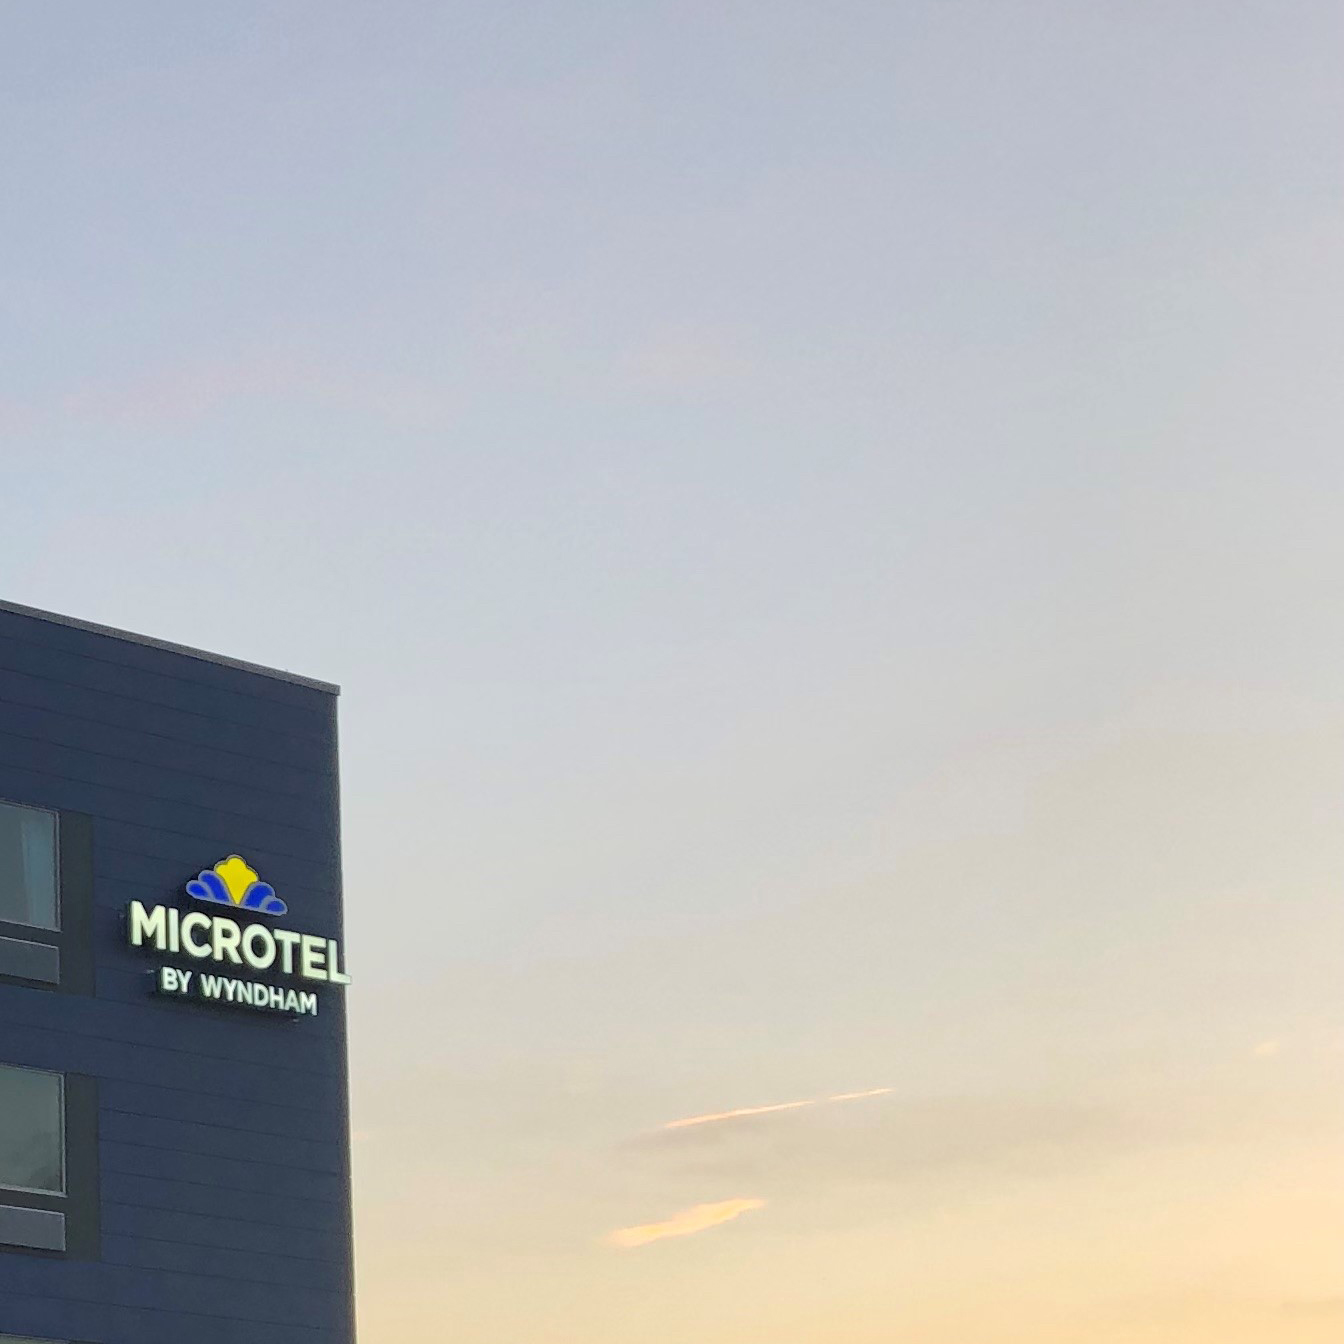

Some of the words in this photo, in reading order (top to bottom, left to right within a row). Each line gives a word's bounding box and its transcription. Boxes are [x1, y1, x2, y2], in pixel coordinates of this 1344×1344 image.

[131, 901, 351, 984] MICROTEL
[162, 966, 192, 993] BY
[201, 973, 318, 1015] WYNDHAM
